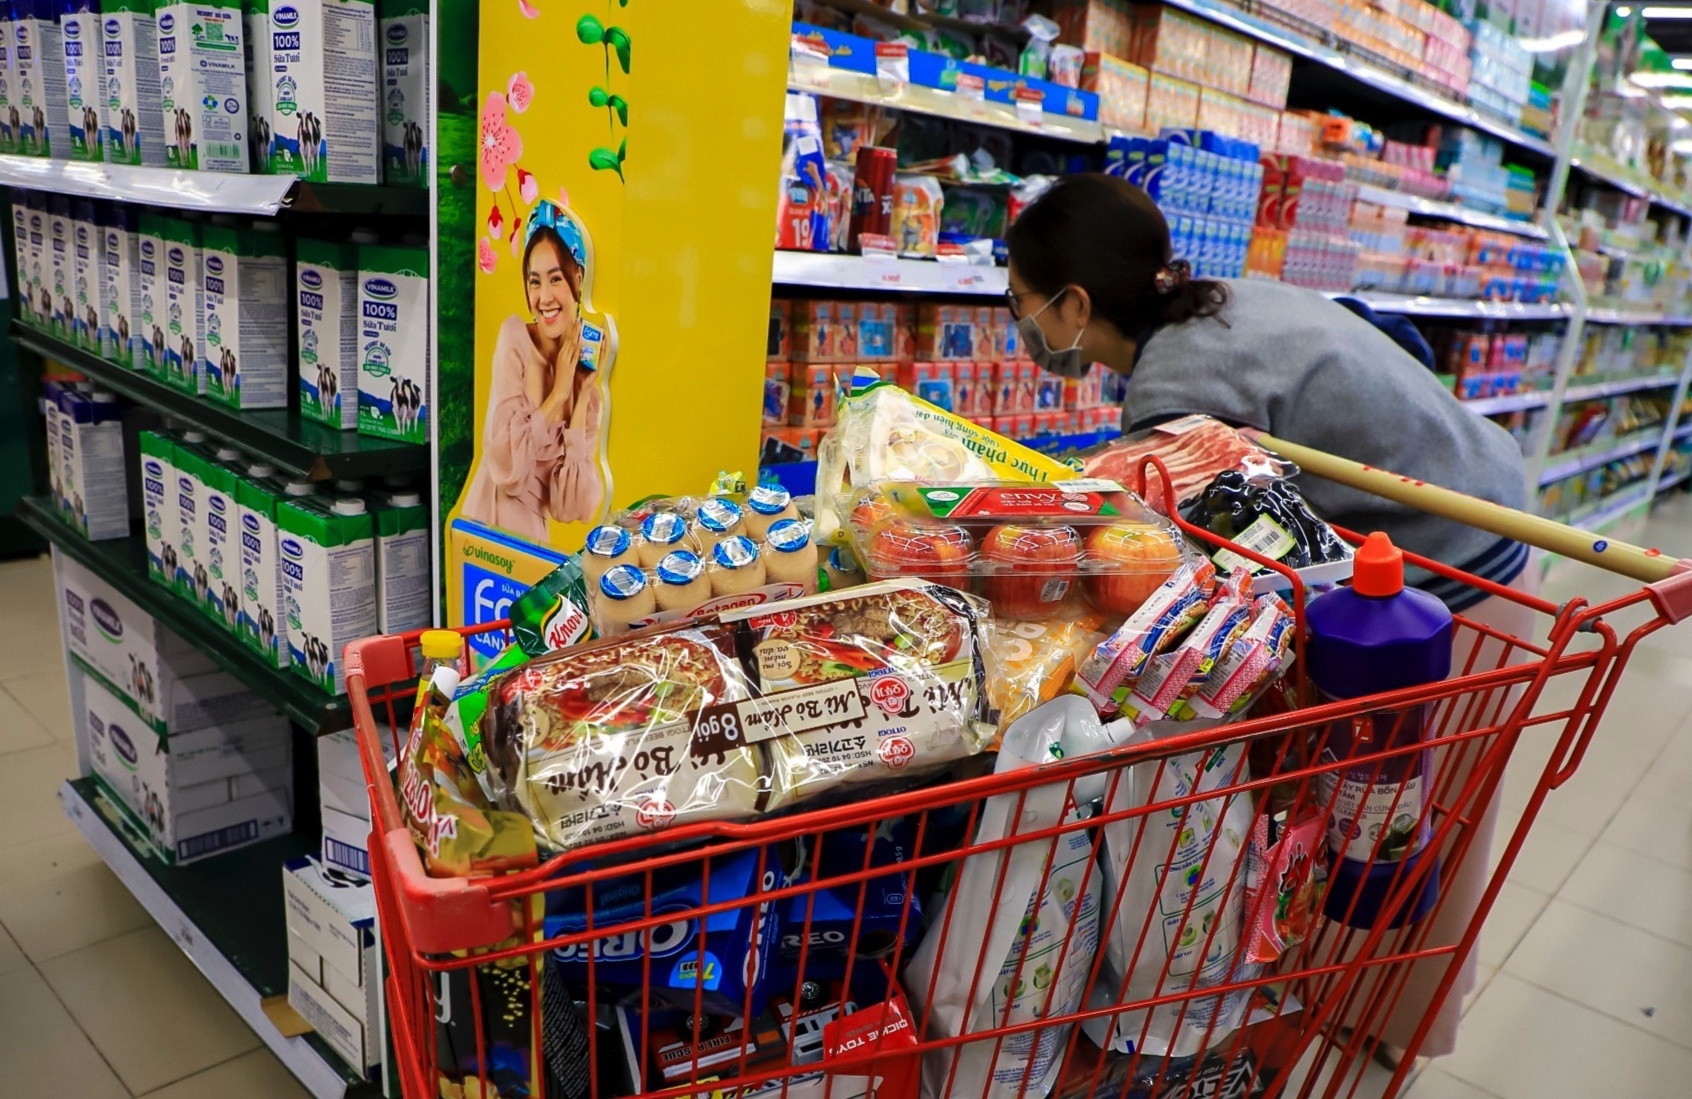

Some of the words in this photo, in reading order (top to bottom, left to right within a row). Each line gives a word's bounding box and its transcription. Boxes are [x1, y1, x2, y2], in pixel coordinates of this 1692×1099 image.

[274, 12, 298, 21] VINAMILK
[274, 35, 298, 48] 100%
[274, 53, 285, 63] Sữa
[285, 52, 300, 63] Tươi
[388, 52, 408, 63] 100%
[208, 61, 236, 70] VINAMILK
[206, 278, 224, 294] 100%
[366, 284, 394, 293] VINAMILK
[302, 294, 322, 308] 100%
[364, 304, 396, 318] 100%
[363, 320, 377, 329] Sữa
[377, 321, 397, 332] Tươi
[1000, 492, 1056, 504] envy
[243, 533, 261, 554] 100%
[474, 546, 514, 574] vinasoy
[282, 560, 302, 580] 100%
[796, 700, 822, 720] Bò
[824, 690, 856, 716] Mì
[745, 704, 793, 732] Hầm
[696, 714, 720, 743] gói
[720, 712, 738, 741] 8
[878, 726, 907, 737] OTTOGI
[634, 746, 680, 782] Bò
